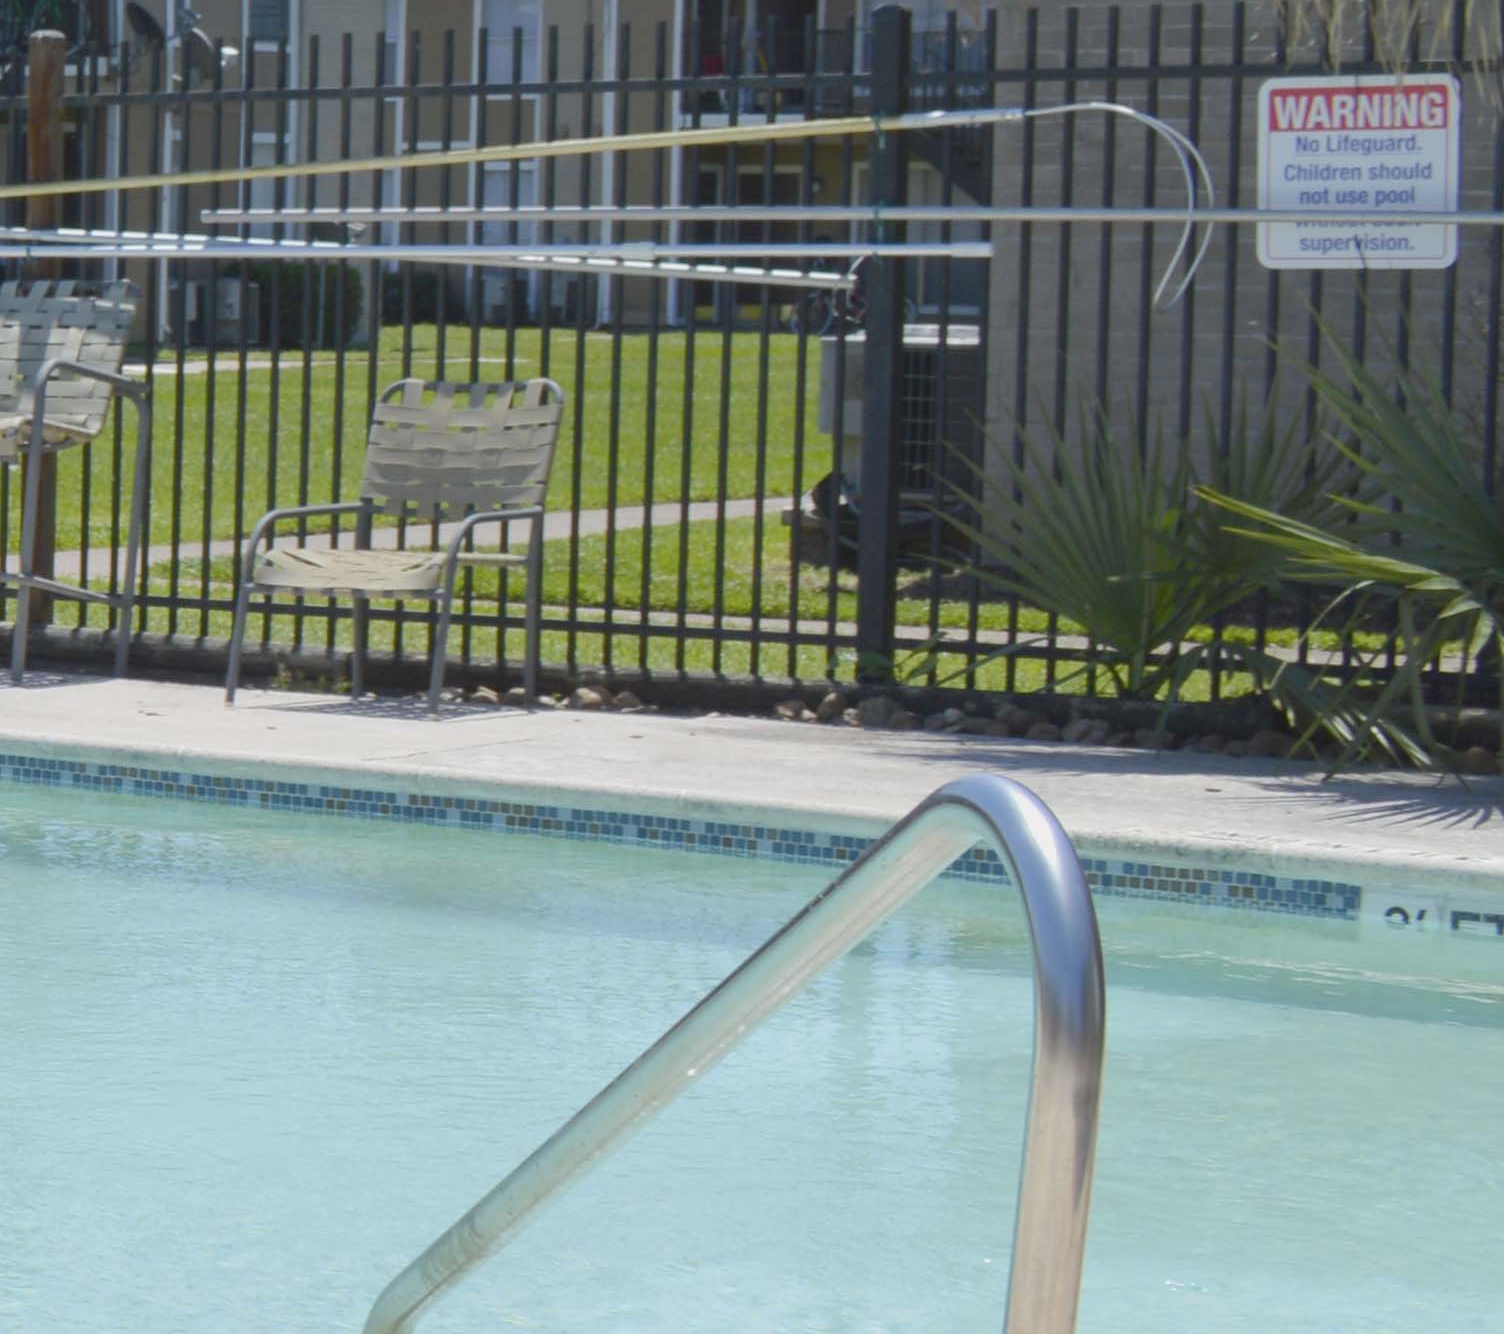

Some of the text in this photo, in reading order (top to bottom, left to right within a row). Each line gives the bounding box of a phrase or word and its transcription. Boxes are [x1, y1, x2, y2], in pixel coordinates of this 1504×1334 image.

[1273, 91, 1445, 130] WARNING
[1295, 135, 1423, 156] No Lifeguard.
[1283, 163, 1433, 182] Children should
[1299, 187, 1416, 207] not use pool
